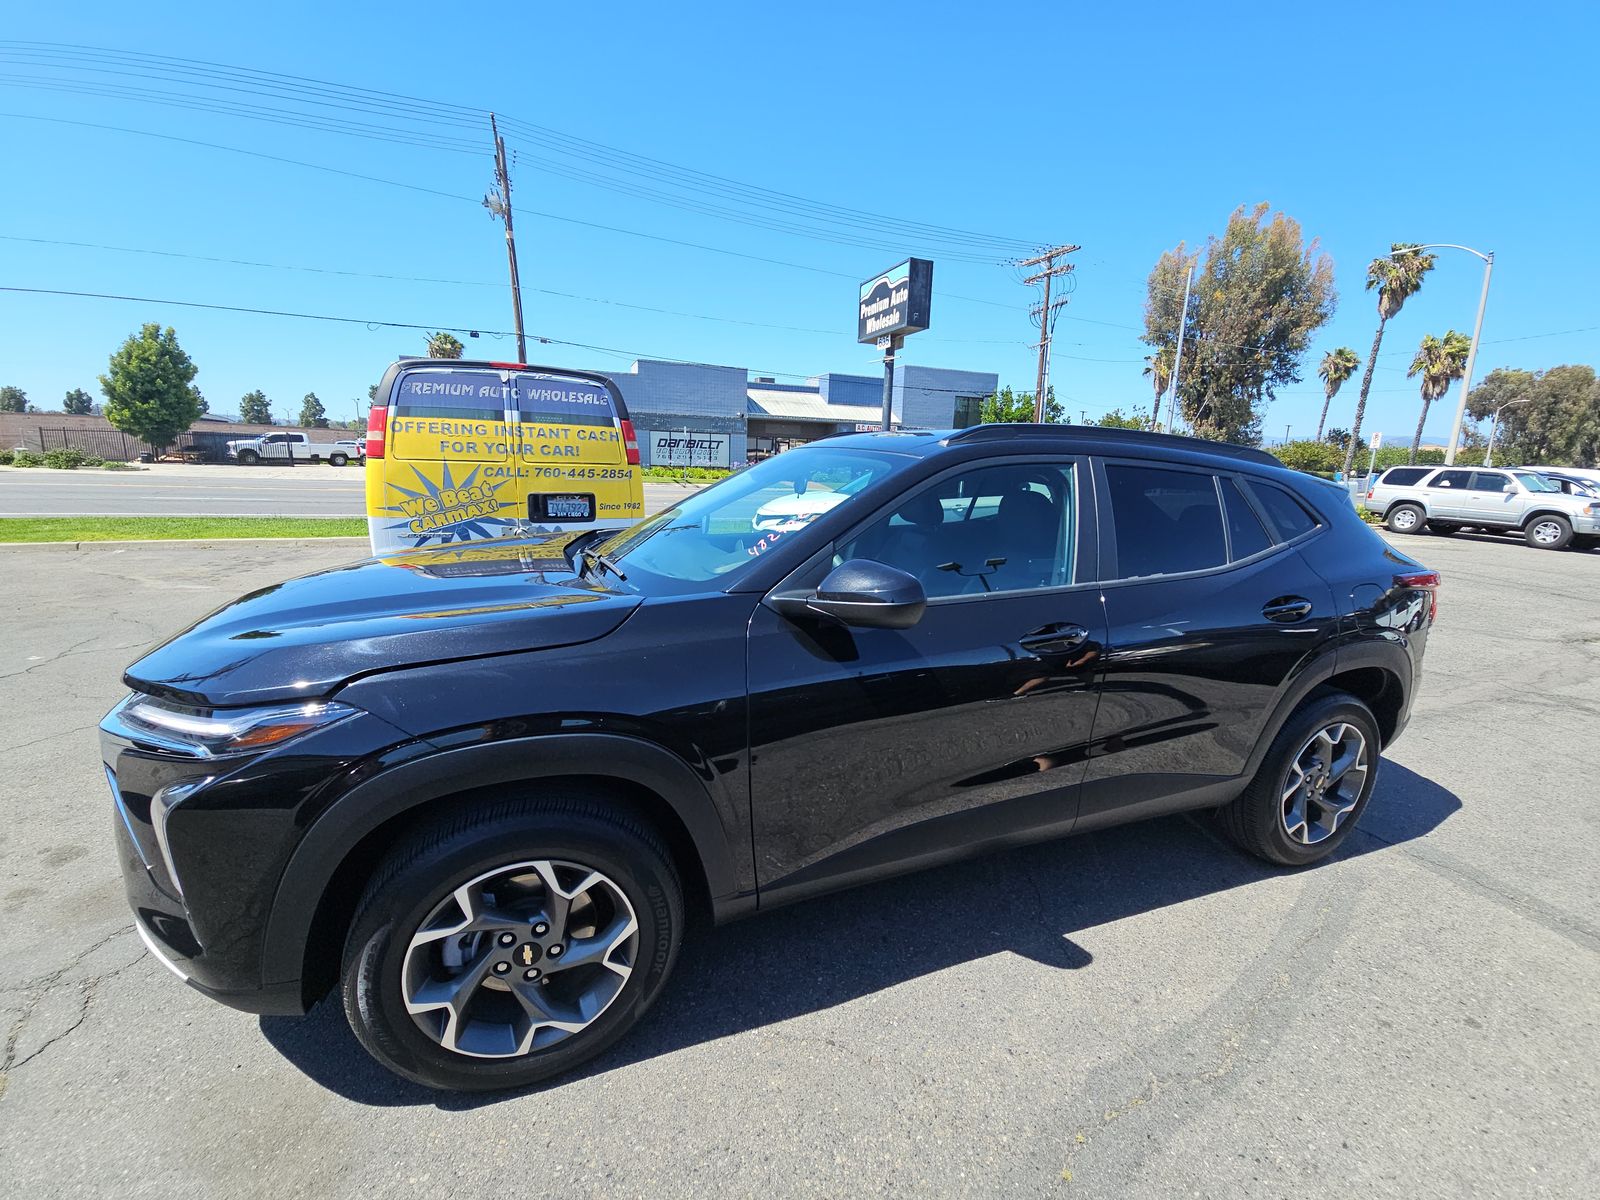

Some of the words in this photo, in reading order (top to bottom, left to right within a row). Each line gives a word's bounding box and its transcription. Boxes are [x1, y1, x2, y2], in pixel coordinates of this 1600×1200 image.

[861, 297, 890, 319] Premium
[891, 288, 908, 307] Auto
[866, 308, 900, 335] Wholesale
[402, 382, 474, 396] PREMIUM
[479, 386, 520, 399] AUTO
[527, 389, 608, 405] WHOLESALE
[391, 421, 487, 436] OFFERING
[494, 425, 571, 440] INSTANT
[577, 429, 620, 442] CASH
[440, 441, 478, 453] FOR
[484, 442, 535, 456] YOUR
[540, 444, 580, 457] CAR!
[483, 466, 529, 478] CALL:
[534, 467, 633, 480] 760-445-2854
[400, 497, 439, 517] We
[439, 480, 494, 509] Beat
[599, 502, 621, 511] Since
[623, 502, 641, 510] 1982
